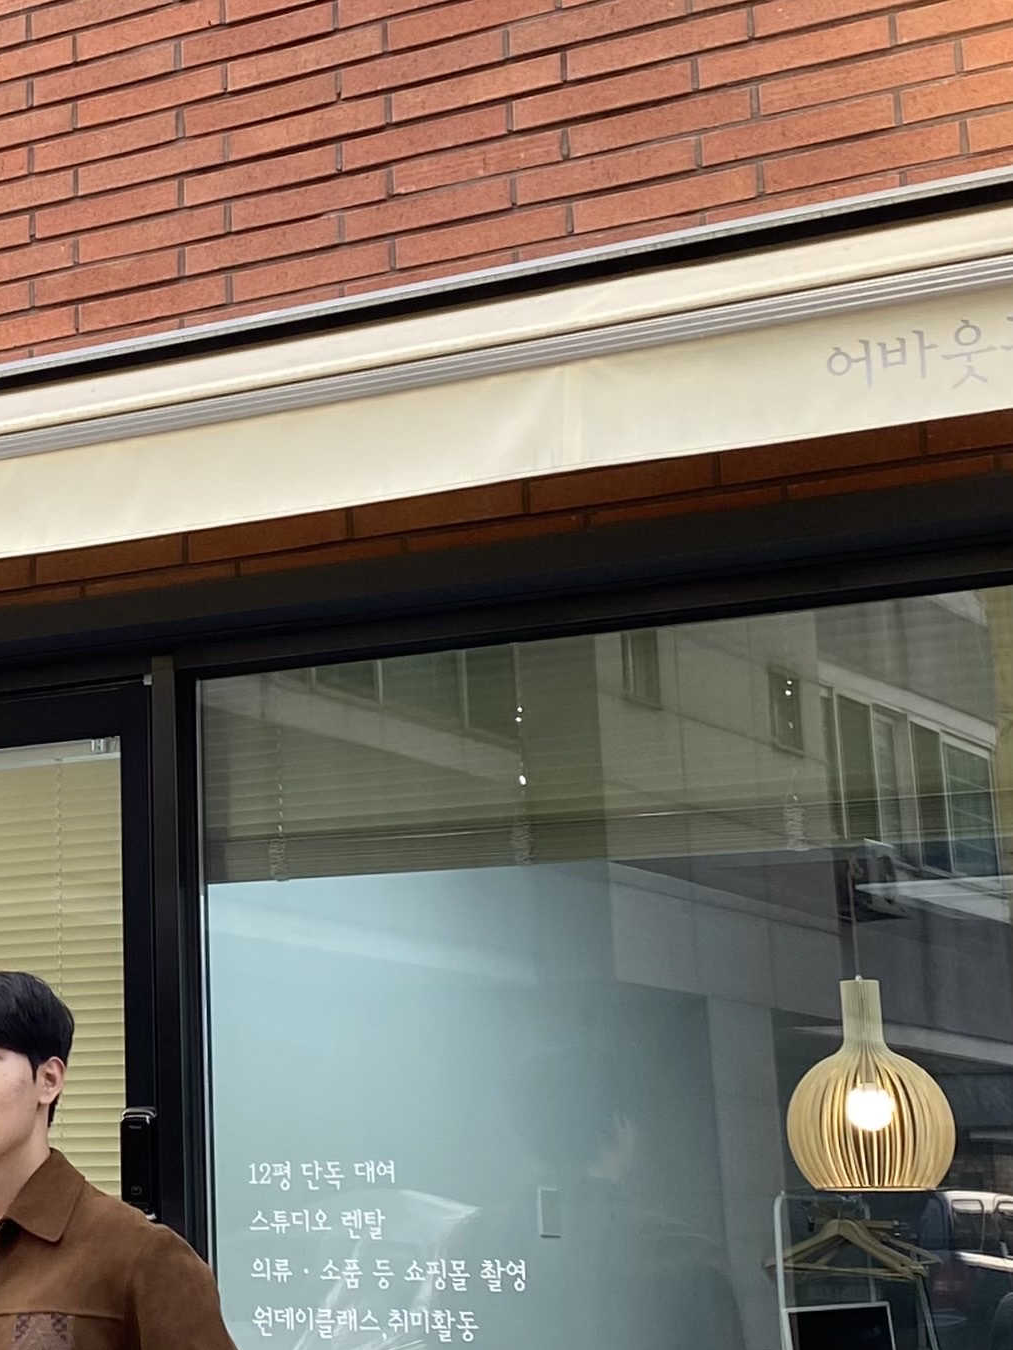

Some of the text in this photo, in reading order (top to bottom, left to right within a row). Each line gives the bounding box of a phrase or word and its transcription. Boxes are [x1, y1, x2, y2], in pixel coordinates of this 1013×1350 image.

[827, 315, 1013, 389] 어바웃
[248, 1159, 396, 1191] 12평 단독 대여
[249, 1208, 386, 1240] 스튜디오 렌탈
[251, 1257, 526, 1293] 의류 소품 등 쇼핑몰 촬영
